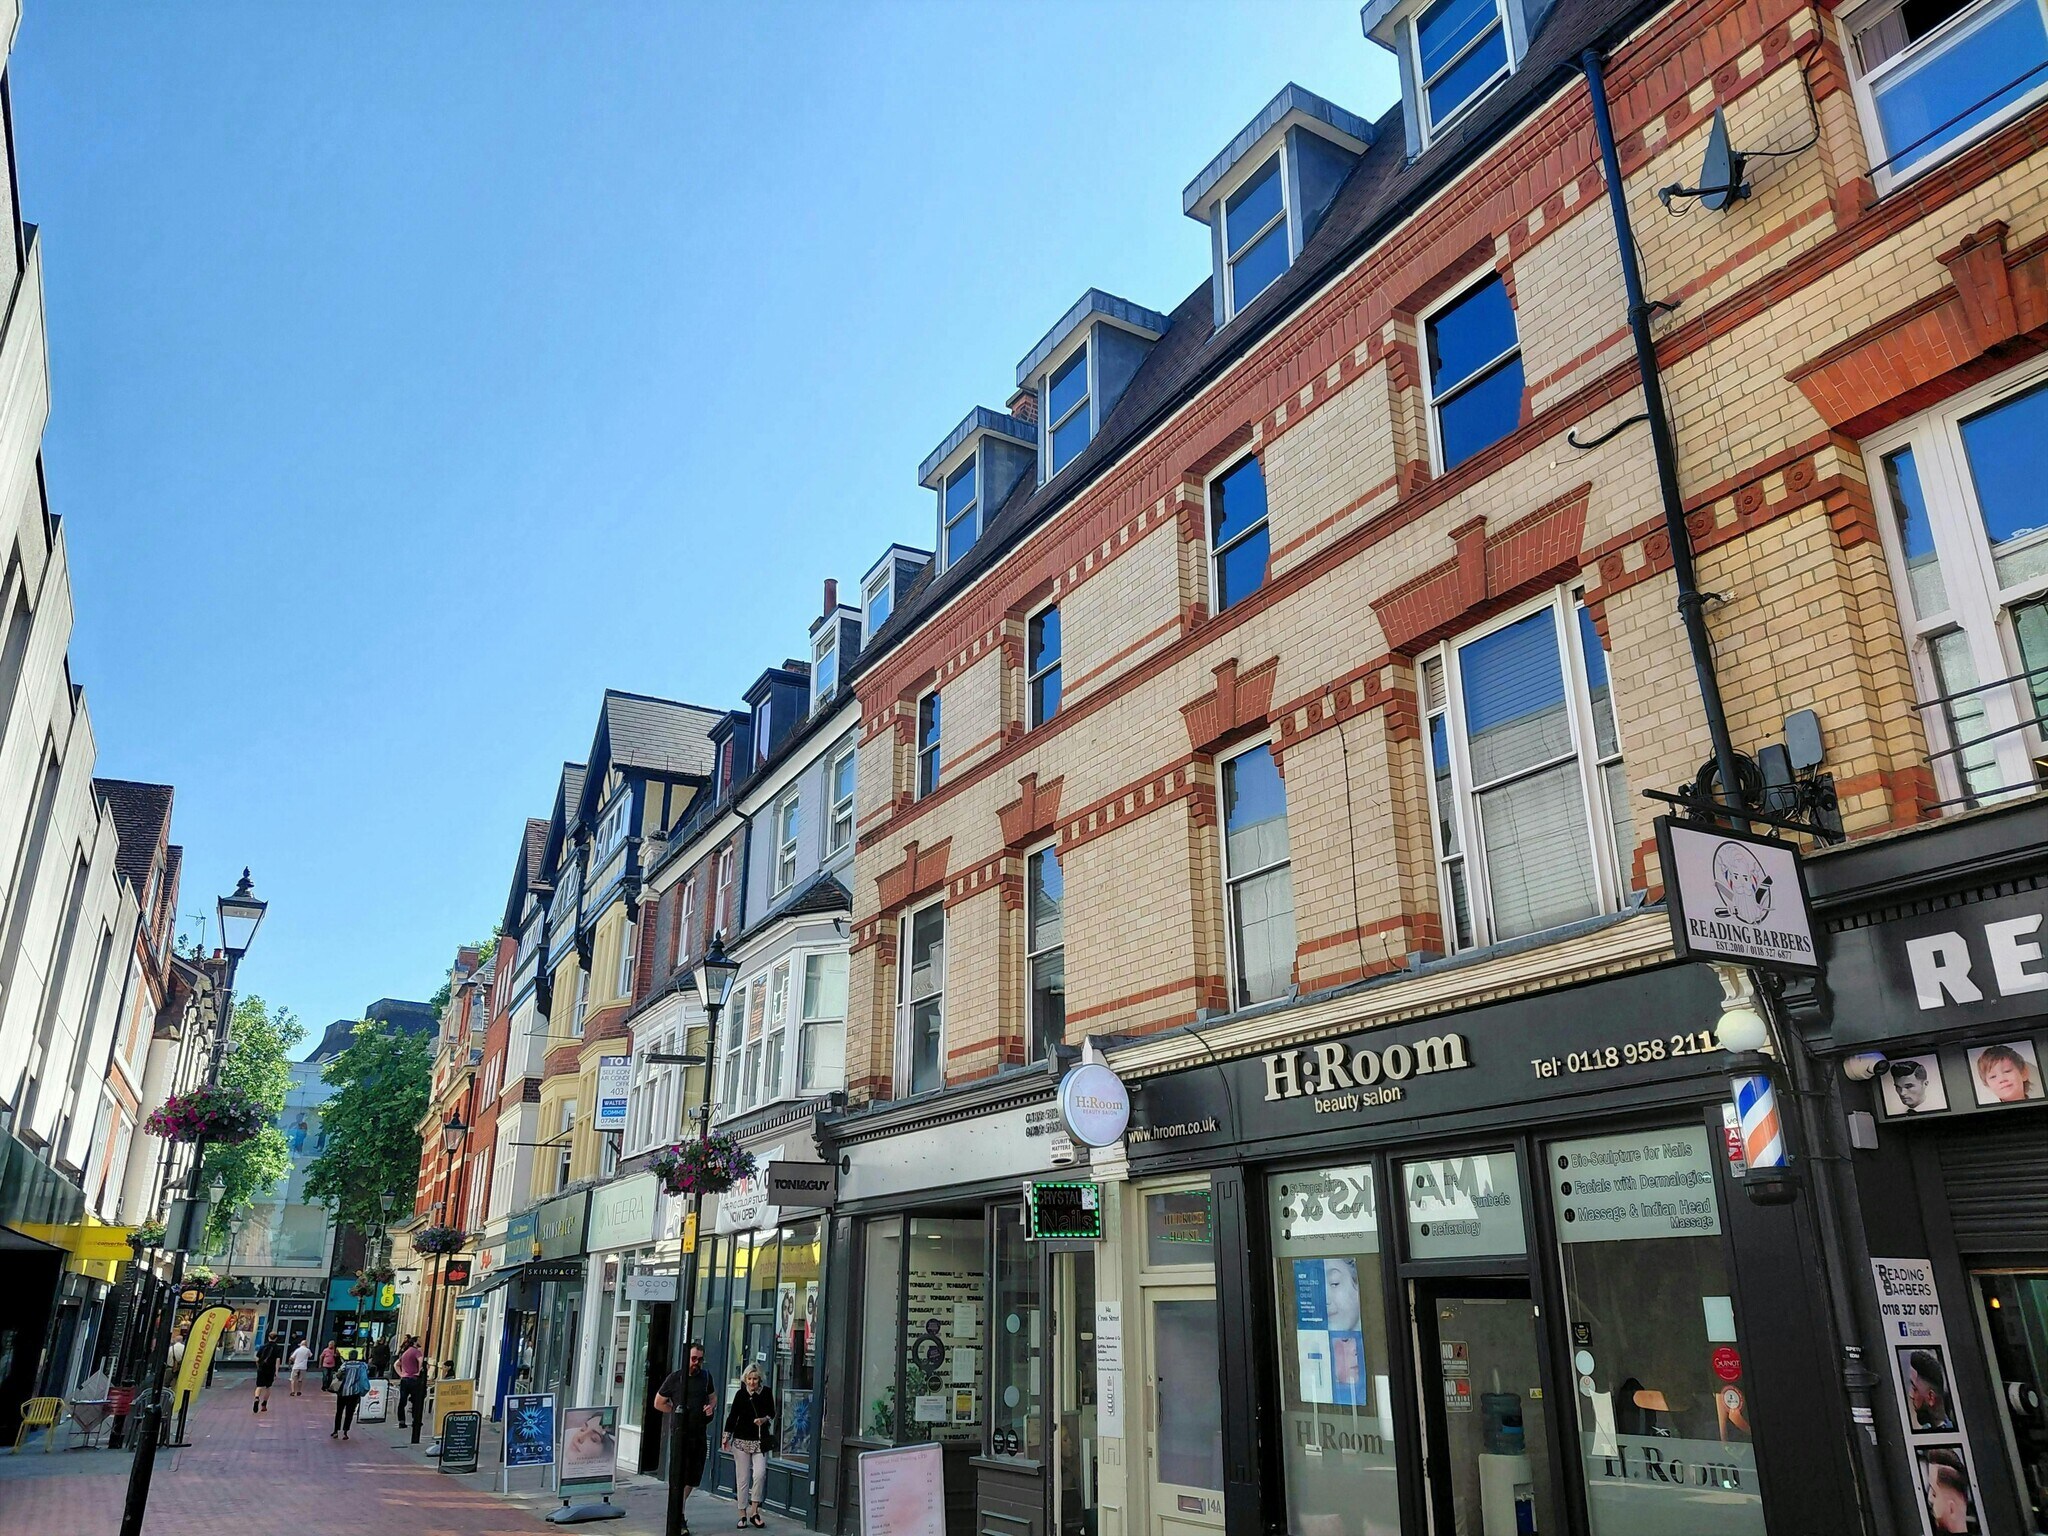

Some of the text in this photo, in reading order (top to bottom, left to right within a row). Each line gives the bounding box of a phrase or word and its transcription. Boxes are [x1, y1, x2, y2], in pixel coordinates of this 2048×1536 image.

[1689, 918, 1811, 952] READING BARBERS
[1750, 946, 1764, 956] 0118
[1765, 947, 1776, 958] 327
[1905, 913, 2048, 1011] RE
[1567, 1047, 1619, 1074] 0118
[1624, 1039, 1666, 1066] 958
[1671, 1030, 1726, 1057] 211
[608, 1057, 624, 1066] TO
[1262, 1033, 1468, 1102] H:Room
[1076, 1095, 1123, 1111] H:Room
[1314, 1086, 1402, 1114] beauty salon
[1128, 1117, 1217, 1144] www.hroom.co.uk
[1571, 1142, 1692, 1169] Bio-Sculpture for Nails
[774, 1179, 830, 1191] TONI&GUY
[1575, 1171, 1711, 1195] Facials with Dermalogica
[1471, 1192, 1511, 1208] Sunbeds
[742, 1206, 758, 1221] OPEN
[1578, 1198, 1711, 1222] Massage & Indian Head
[1042, 1209, 1093, 1233] Nails
[1432, 1221, 1482, 1237] Reflexology
[1671, 1215, 1713, 1230] Massage
[1878, 1264, 1924, 1282] READING
[1883, 1280, 1932, 1296] BARBERS
[1882, 1304, 1939, 1316] 0118 327 6877
[1909, 1328, 1931, 1337] Facebook
[1442, 1344, 1454, 1359] NO
[1714, 1357, 1741, 1368] GUINOT
[1445, 1380, 1457, 1396] NO
[509, 1445, 552, 1454] TATTOO
[1207, 1497, 1222, 1514] 14A
